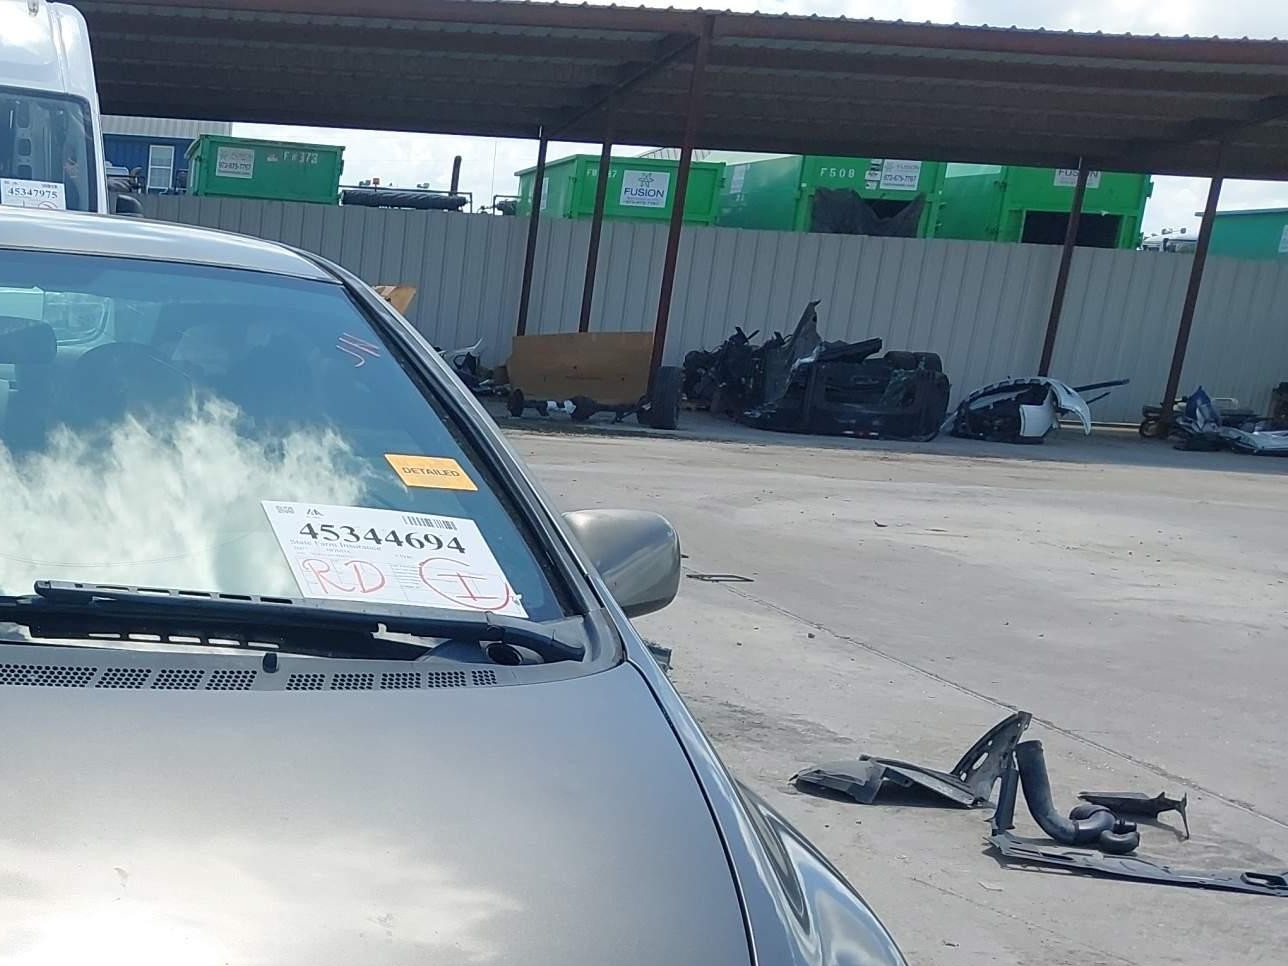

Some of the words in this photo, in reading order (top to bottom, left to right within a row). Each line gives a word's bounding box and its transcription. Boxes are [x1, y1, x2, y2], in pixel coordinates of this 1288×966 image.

[1058, 169, 1098, 177] FUSN
[8, 187, 58, 199] 45347975
[624, 187, 664, 198] FUSION
[401, 467, 460, 477] DETAILED
[299, 522, 466, 554] 45344694
